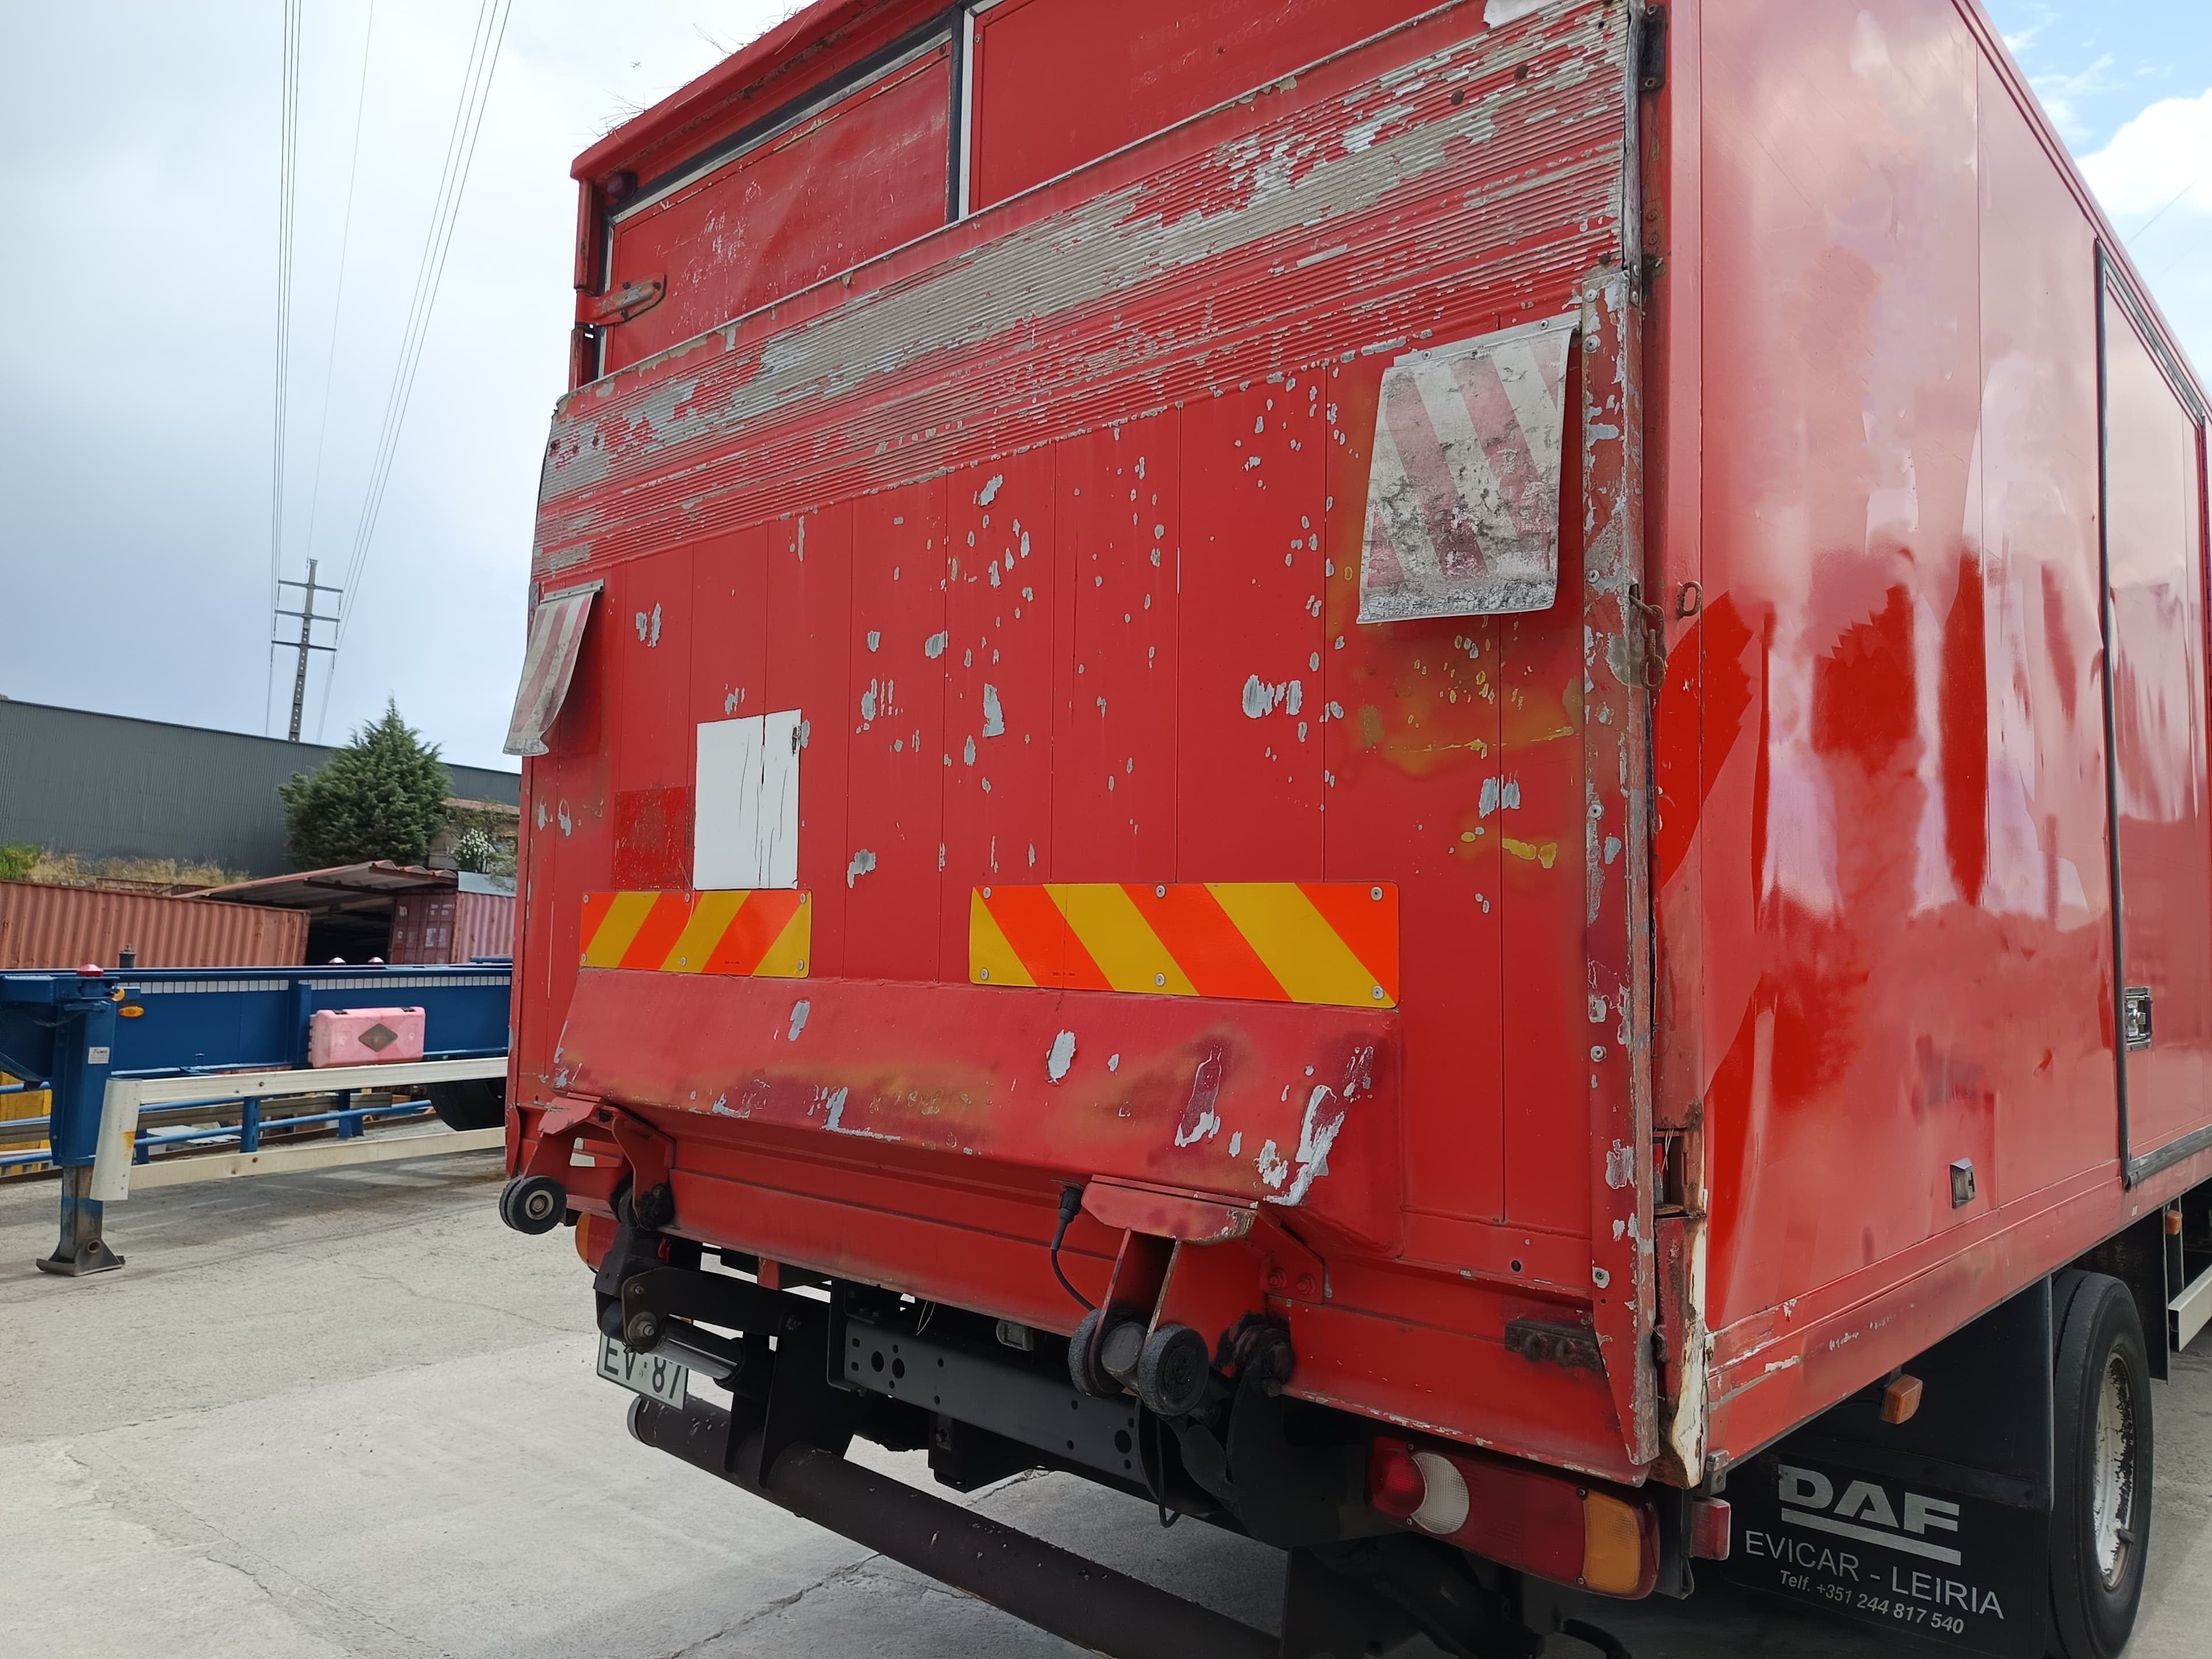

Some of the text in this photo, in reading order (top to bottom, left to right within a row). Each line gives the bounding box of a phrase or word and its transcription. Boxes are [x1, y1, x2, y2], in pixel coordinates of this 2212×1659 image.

[1778, 1464, 1960, 1535] DAF
[1746, 1530, 1859, 1582] EVICAR
[1892, 1566, 2005, 1620] LEIRIA
[1780, 1570, 1964, 1634] Telf. +351 244 817 540
